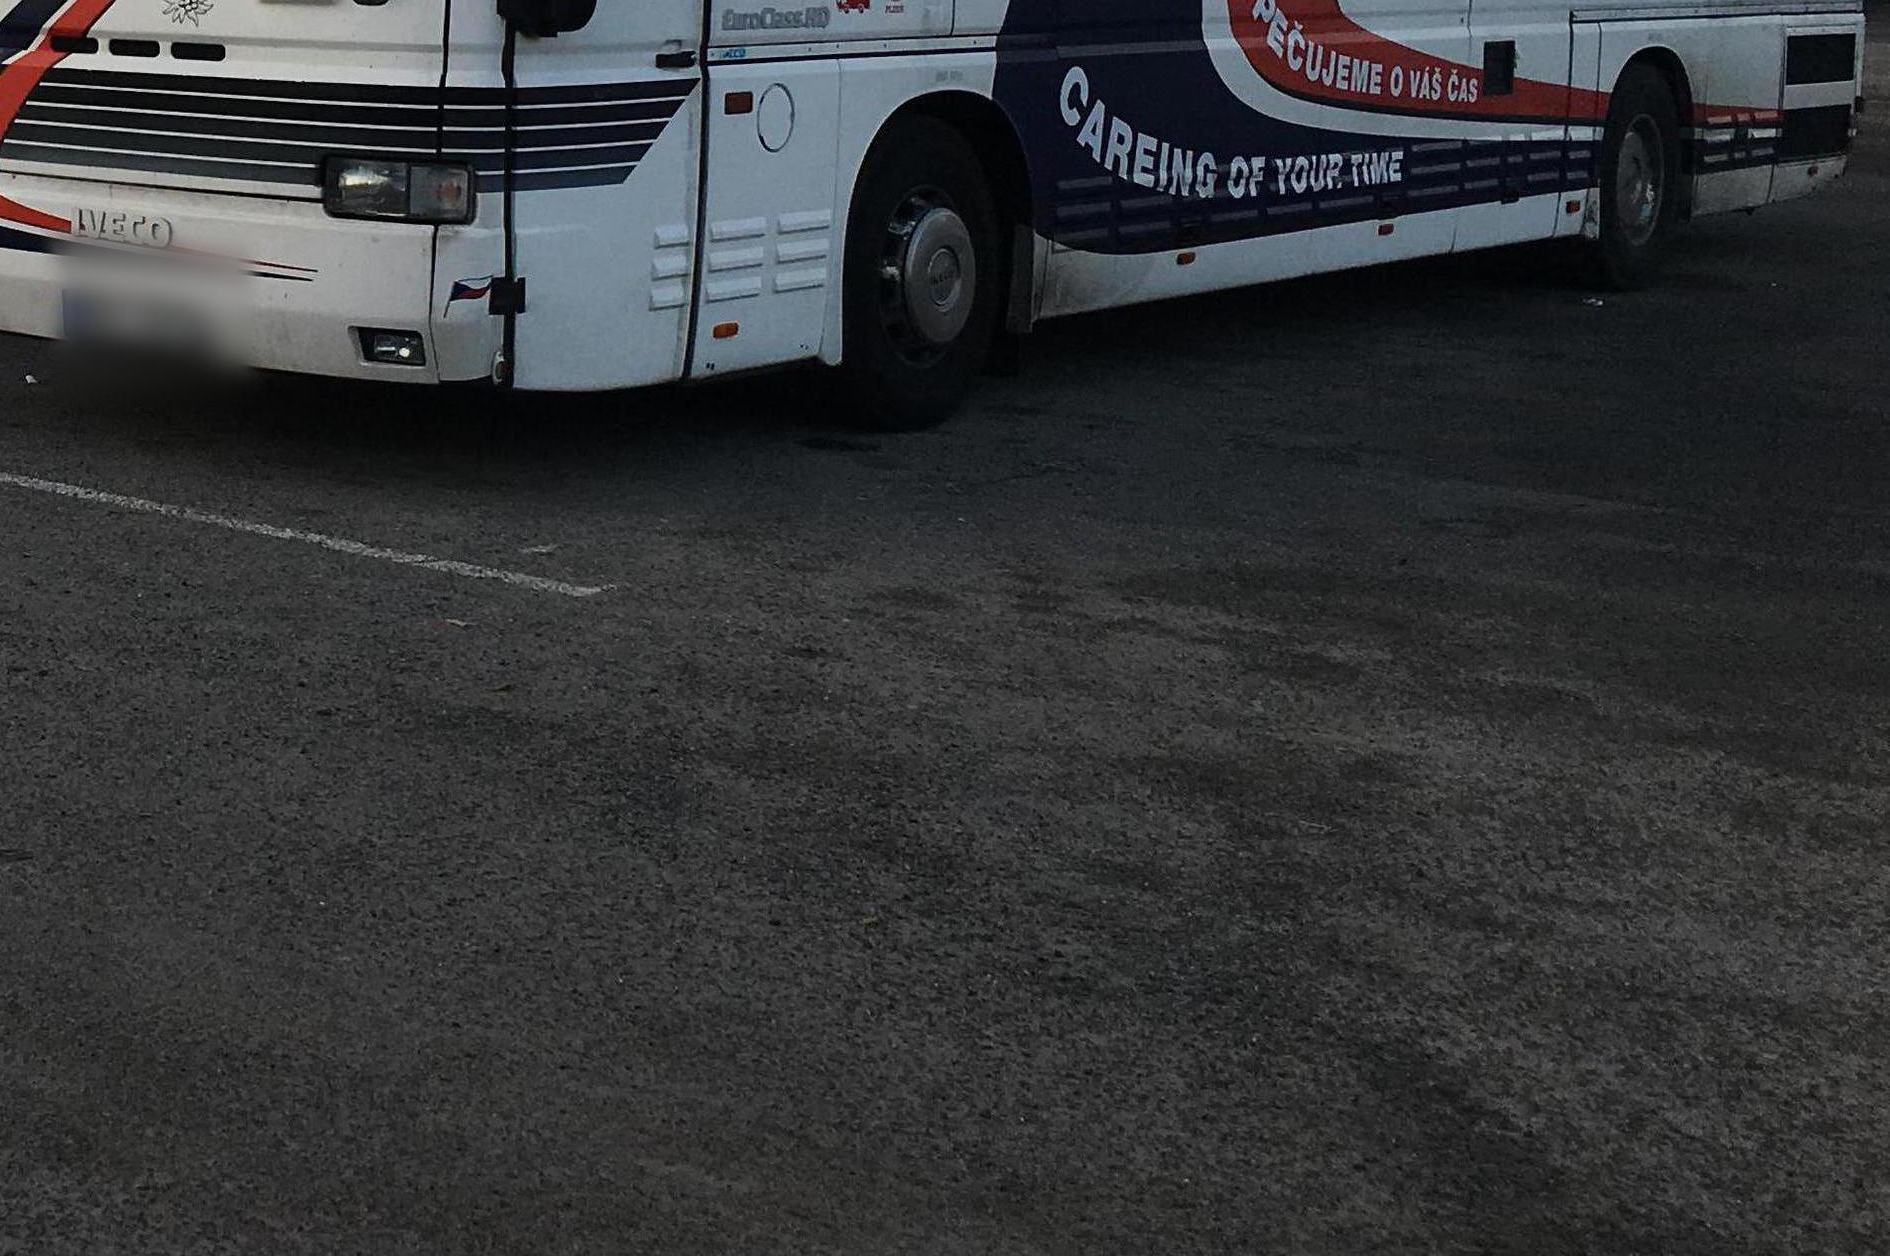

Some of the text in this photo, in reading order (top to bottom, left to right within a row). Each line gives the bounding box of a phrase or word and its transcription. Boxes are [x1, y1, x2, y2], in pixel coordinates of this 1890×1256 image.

[1389, 65, 1404, 98] O
[1409, 66, 1442, 101] VÁŠ
[1447, 68, 1479, 104] ČAS
[1059, 65, 1404, 199] CAREING OF YOUR TIME
[72, 207, 173, 248] IVECO
